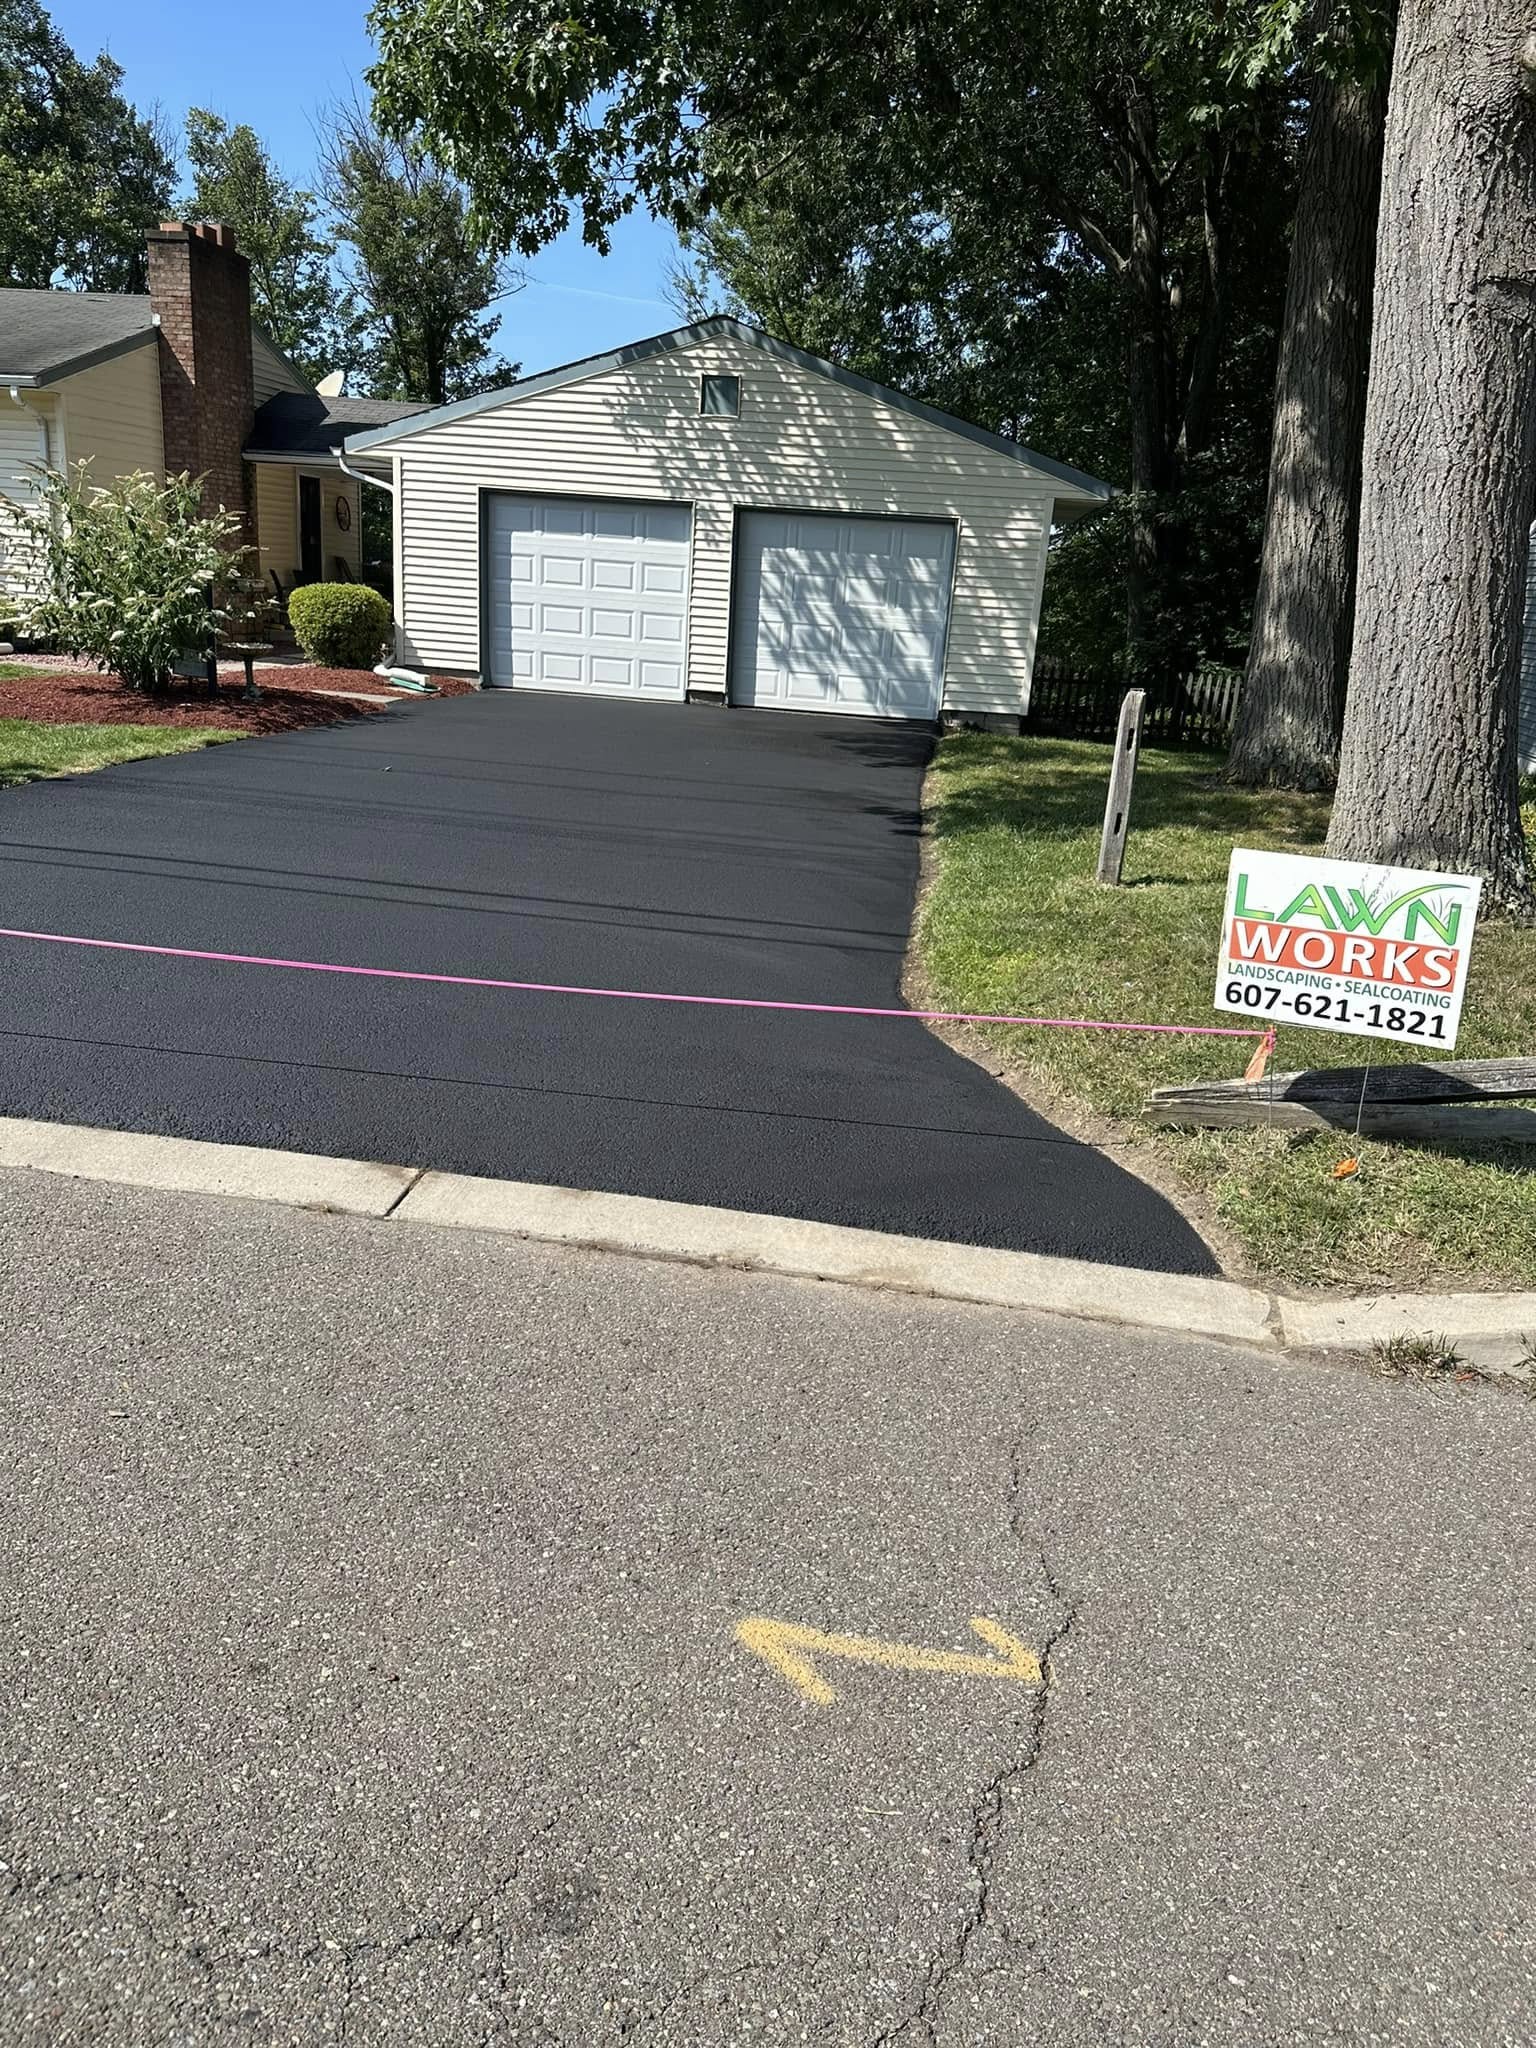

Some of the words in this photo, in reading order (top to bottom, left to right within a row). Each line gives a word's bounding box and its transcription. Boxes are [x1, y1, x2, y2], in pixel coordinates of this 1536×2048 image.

[1234, 873, 1470, 946] LAWN
[1227, 963, 1332, 990] LANDSCAPING
[1343, 981, 1451, 1009] SEALCOATING
[1234, 921, 1455, 989] WORKS
[1225, 981, 1447, 1040] 607-621-1821
